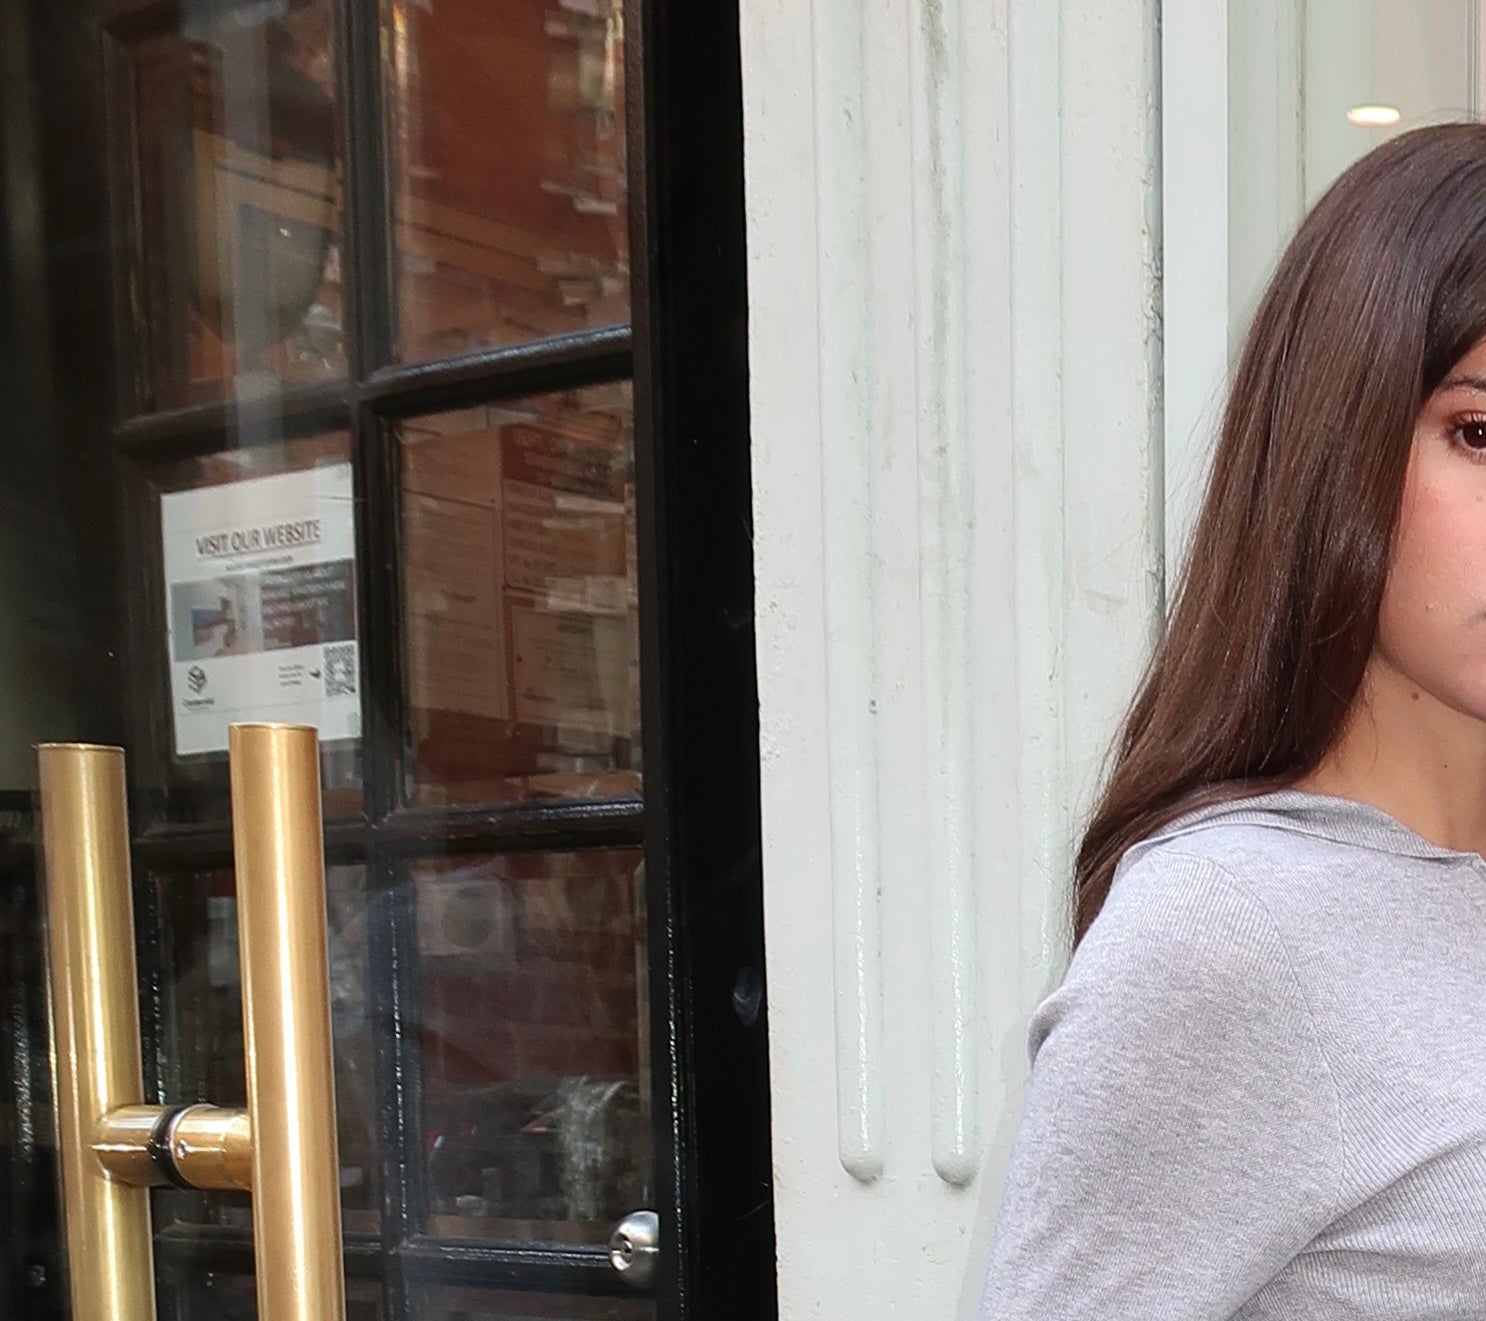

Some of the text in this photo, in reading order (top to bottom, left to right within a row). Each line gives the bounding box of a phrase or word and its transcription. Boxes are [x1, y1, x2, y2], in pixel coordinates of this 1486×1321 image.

[195, 520, 321, 555] VISIT OUR WEBSITE
